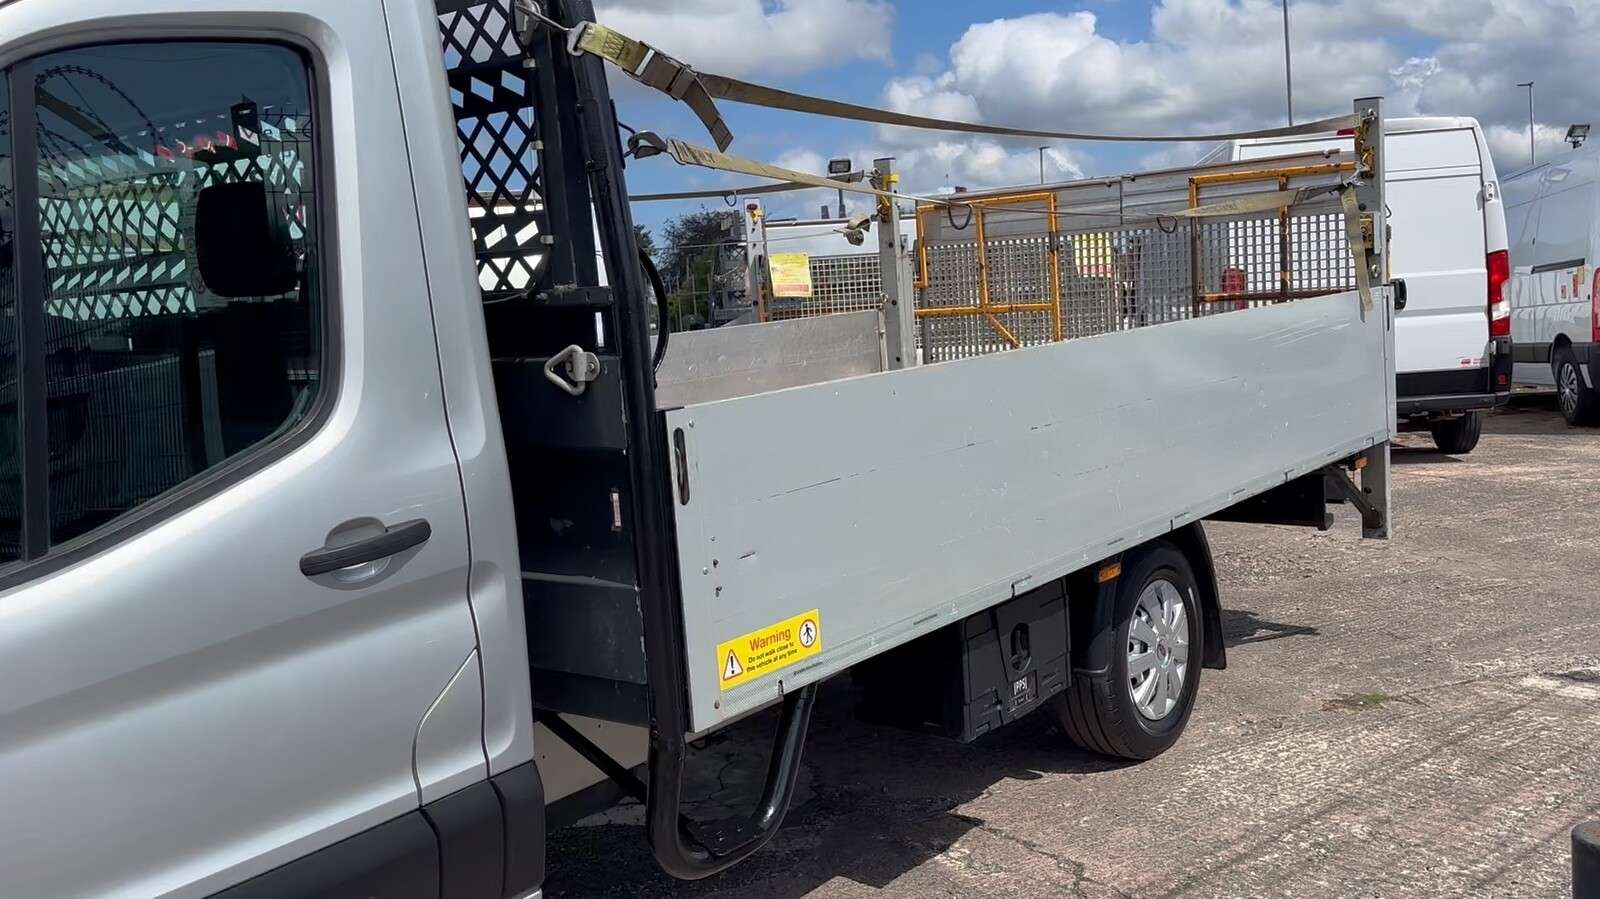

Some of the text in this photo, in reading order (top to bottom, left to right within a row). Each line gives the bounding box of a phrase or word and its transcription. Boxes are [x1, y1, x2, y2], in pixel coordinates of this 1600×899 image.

[749, 629, 791, 651] Warning
[756, 652, 765, 660] not
[765, 648, 776, 656] walk
[756, 658, 772, 669] vehicle
